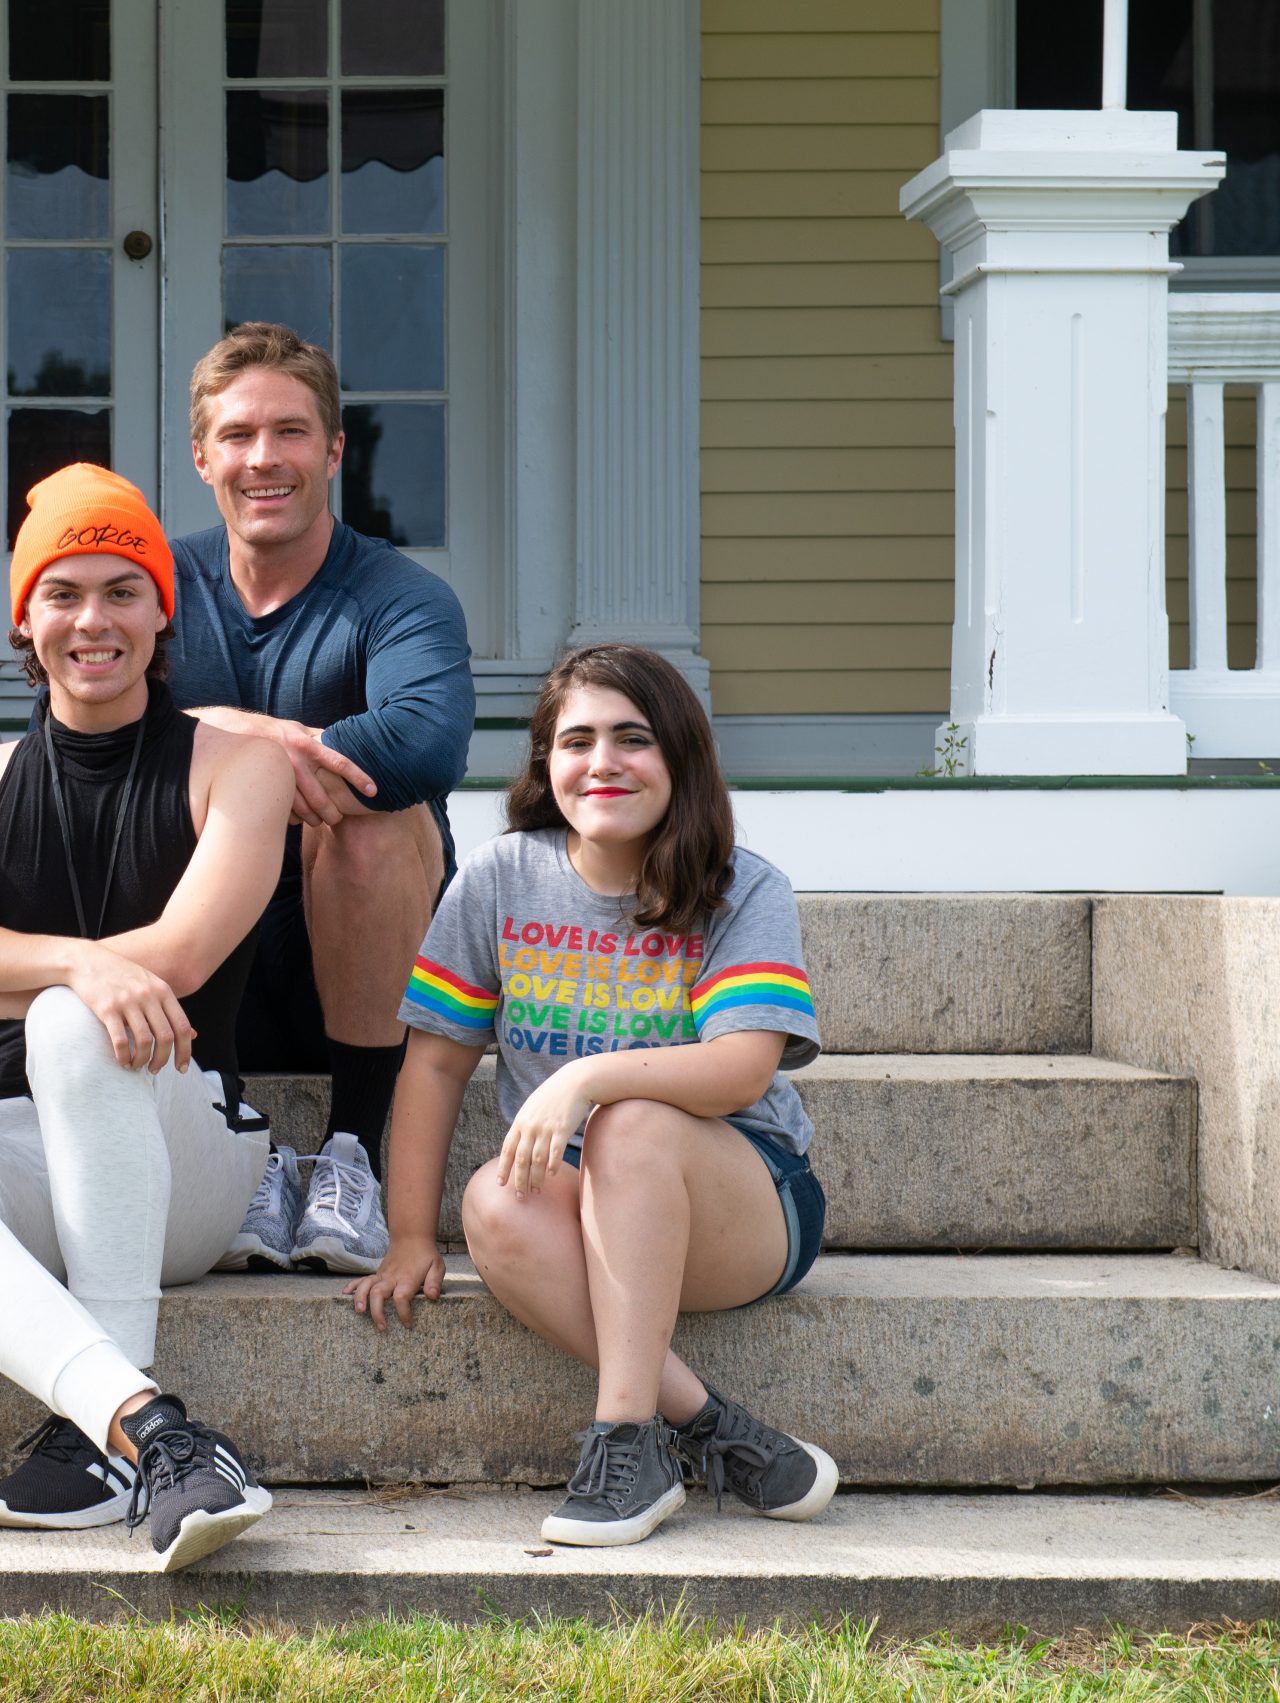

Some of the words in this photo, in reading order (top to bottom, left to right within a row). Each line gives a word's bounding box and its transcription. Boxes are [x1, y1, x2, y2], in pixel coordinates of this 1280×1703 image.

[57, 523, 149, 555] GORGE
[501, 916, 583, 951] LOVE
[587, 930, 619, 954] IS
[623, 932, 704, 959] LOVE
[499, 943, 582, 979] LOVE
[587, 955, 612, 981] IS
[617, 958, 702, 985] LOVE
[583, 982, 610, 1009] IS
[505, 1000, 571, 1031] OVE
[578, 1008, 609, 1035] IS
[613, 1012, 697, 1040] LOVE
[575, 1034, 605, 1058] IS
[140, 1417, 164, 1439] adidas
